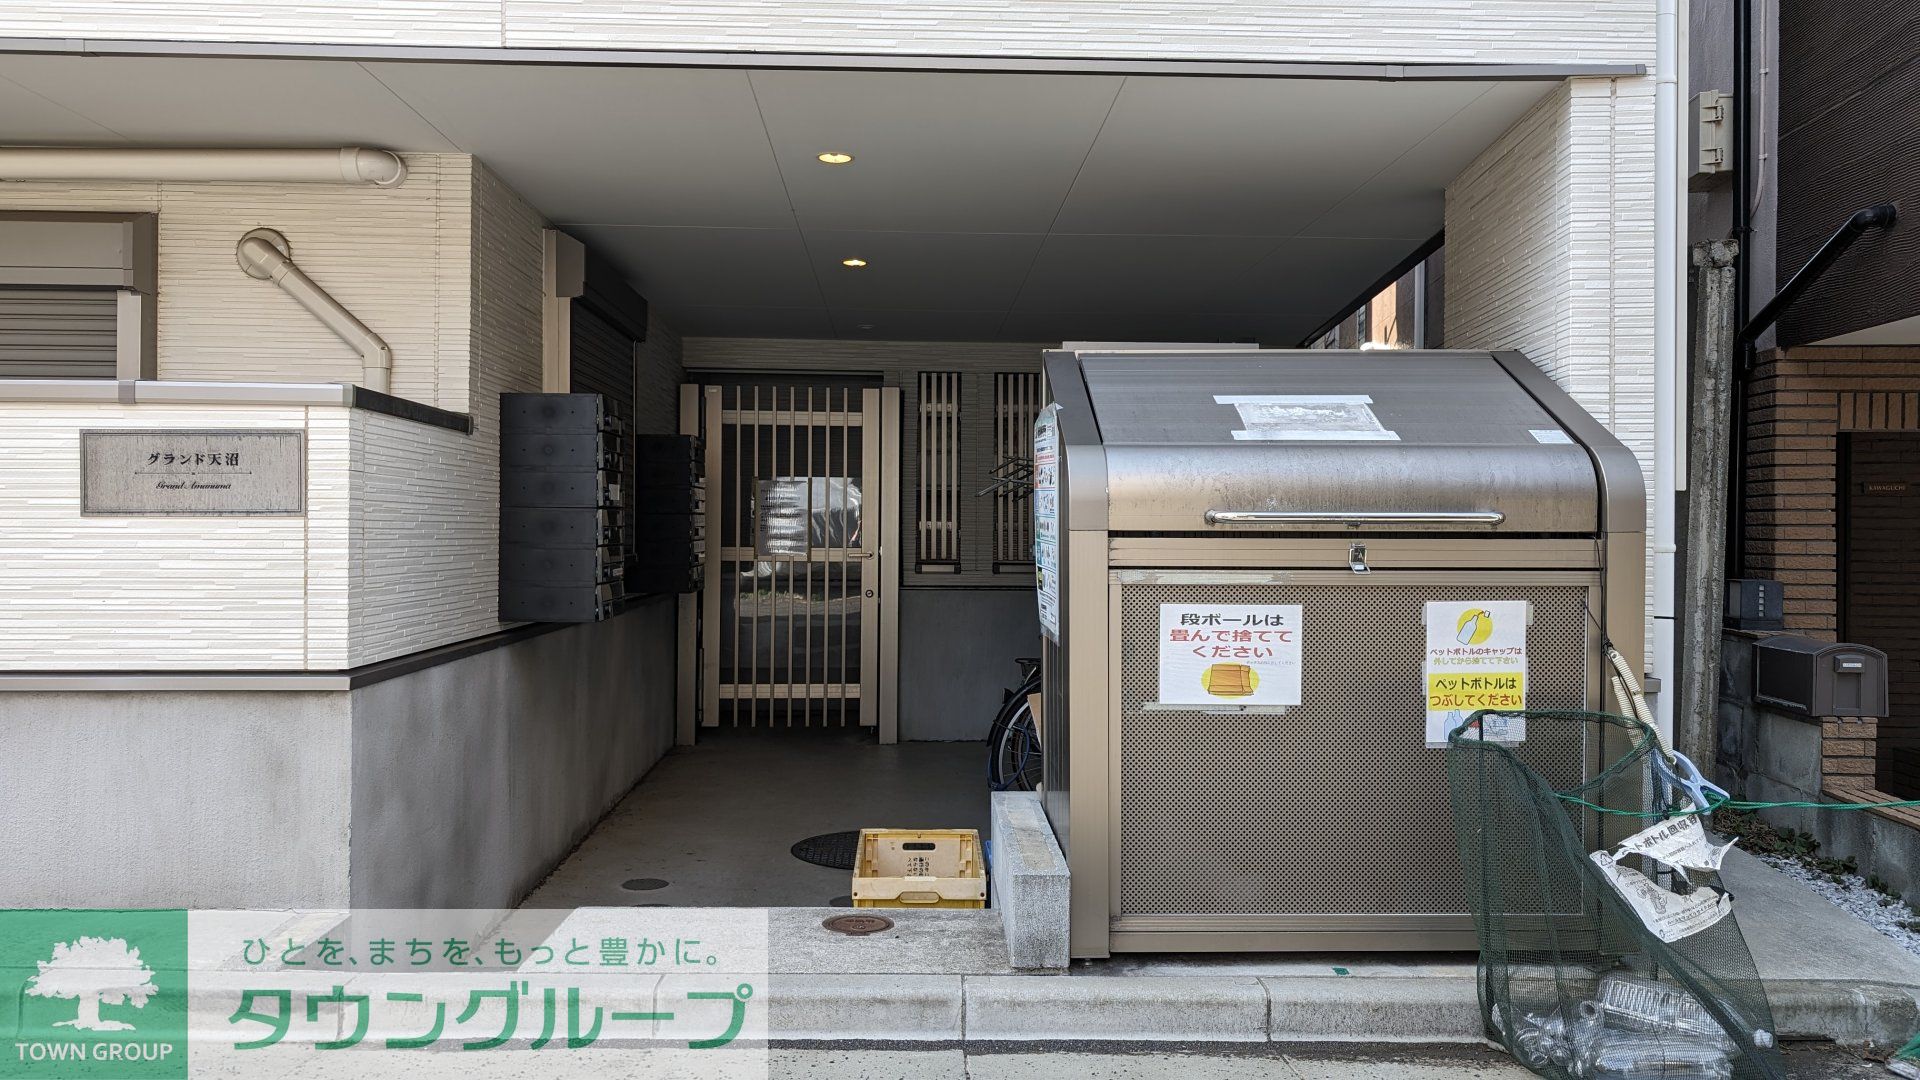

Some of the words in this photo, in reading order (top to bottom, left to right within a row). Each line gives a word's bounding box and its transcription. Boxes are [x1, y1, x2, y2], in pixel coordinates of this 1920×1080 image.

[148, 453, 239, 466] グランド天沼
[156, 481, 186, 490] Grand
[1181, 613, 1284, 626] 段ボールは
[1169, 629, 1293, 643] 畳んで捨てて
[1192, 645, 1273, 658] ください
[1430, 647, 1522, 655] ペットボトルのキャップは
[1435, 677, 1517, 690] ペットボトルは
[1430, 694, 1522, 707] つぶしてください
